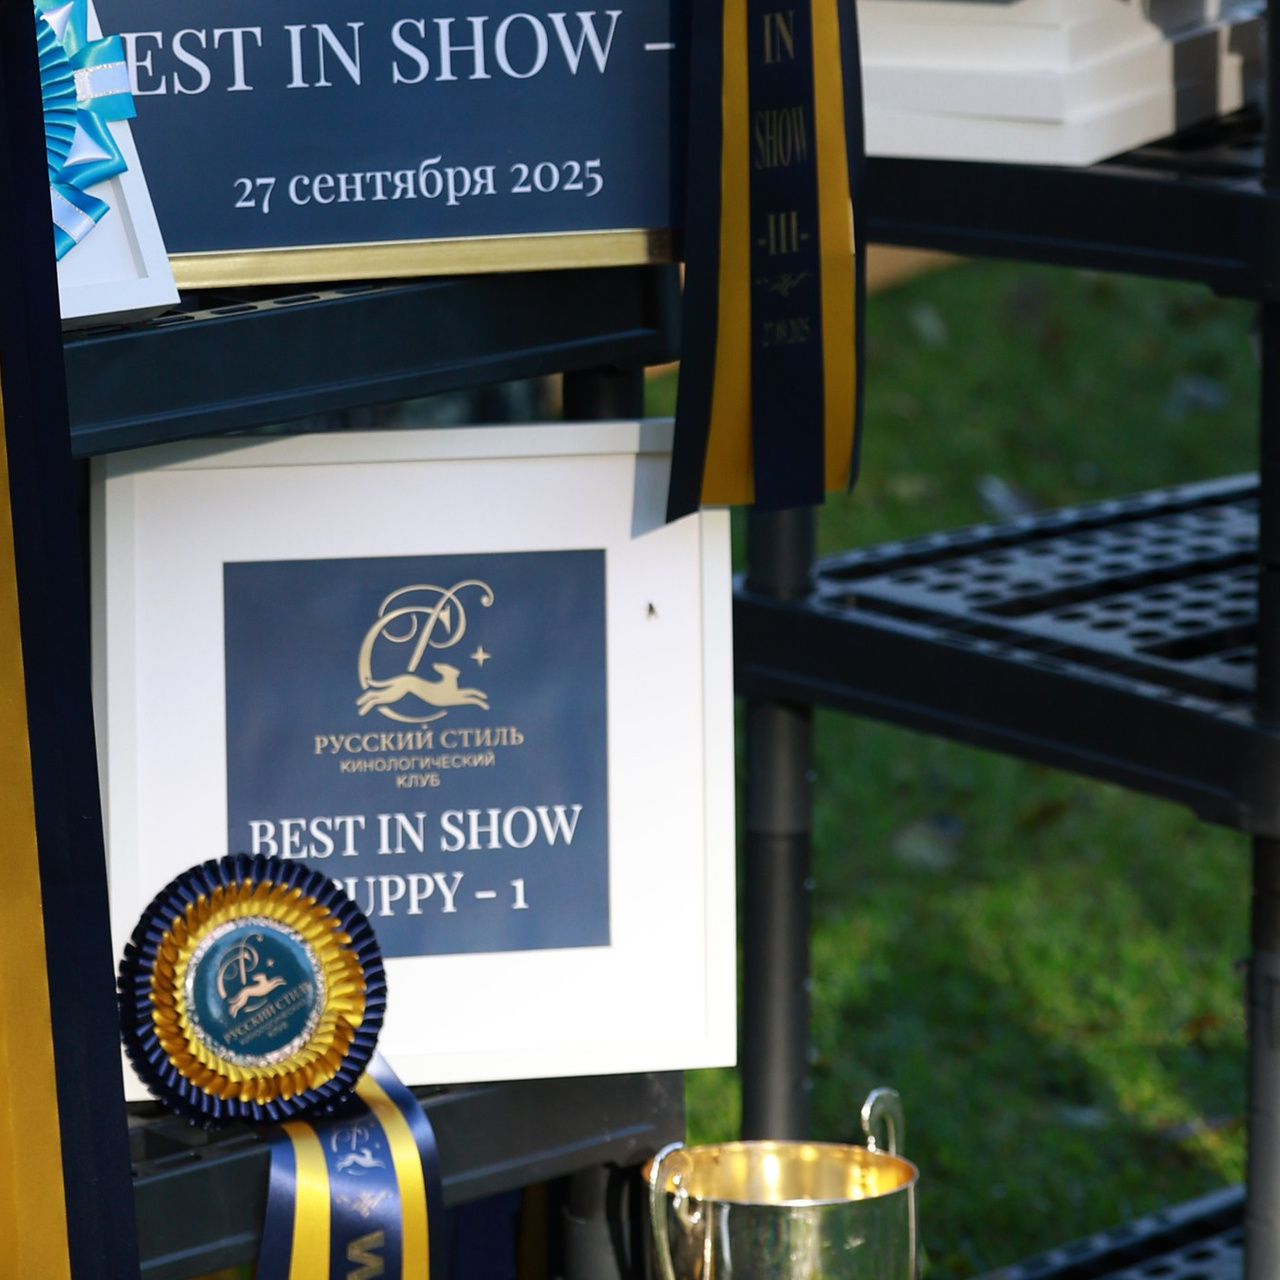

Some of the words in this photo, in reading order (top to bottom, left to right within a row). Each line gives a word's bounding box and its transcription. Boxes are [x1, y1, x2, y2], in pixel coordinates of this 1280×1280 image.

[120, 26, 263, 96] EST
[284, 21, 365, 89] IN
[391, 9, 623, 85] SHOW
[763, 10, 795, 64] IN
[754, 106, 808, 170] SHOW
[233, 176, 276, 214] 27
[288, 155, 497, 205] сентября
[511, 157, 604, 197] 2025
[314, 724, 433, 755] РУССКИЙ
[440, 726, 524, 749] СТИЛЬ
[339, 751, 495, 773] КИНОЛОГИЧЕСКИЙ
[395, 773, 441, 789] КЛУБ
[249, 816, 365, 861] BEST
[377, 812, 428, 855] IN
[440, 804, 583, 852] SHOW
[331, 872, 464, 917] UPPY
[510, 878, 529, 909] 1
